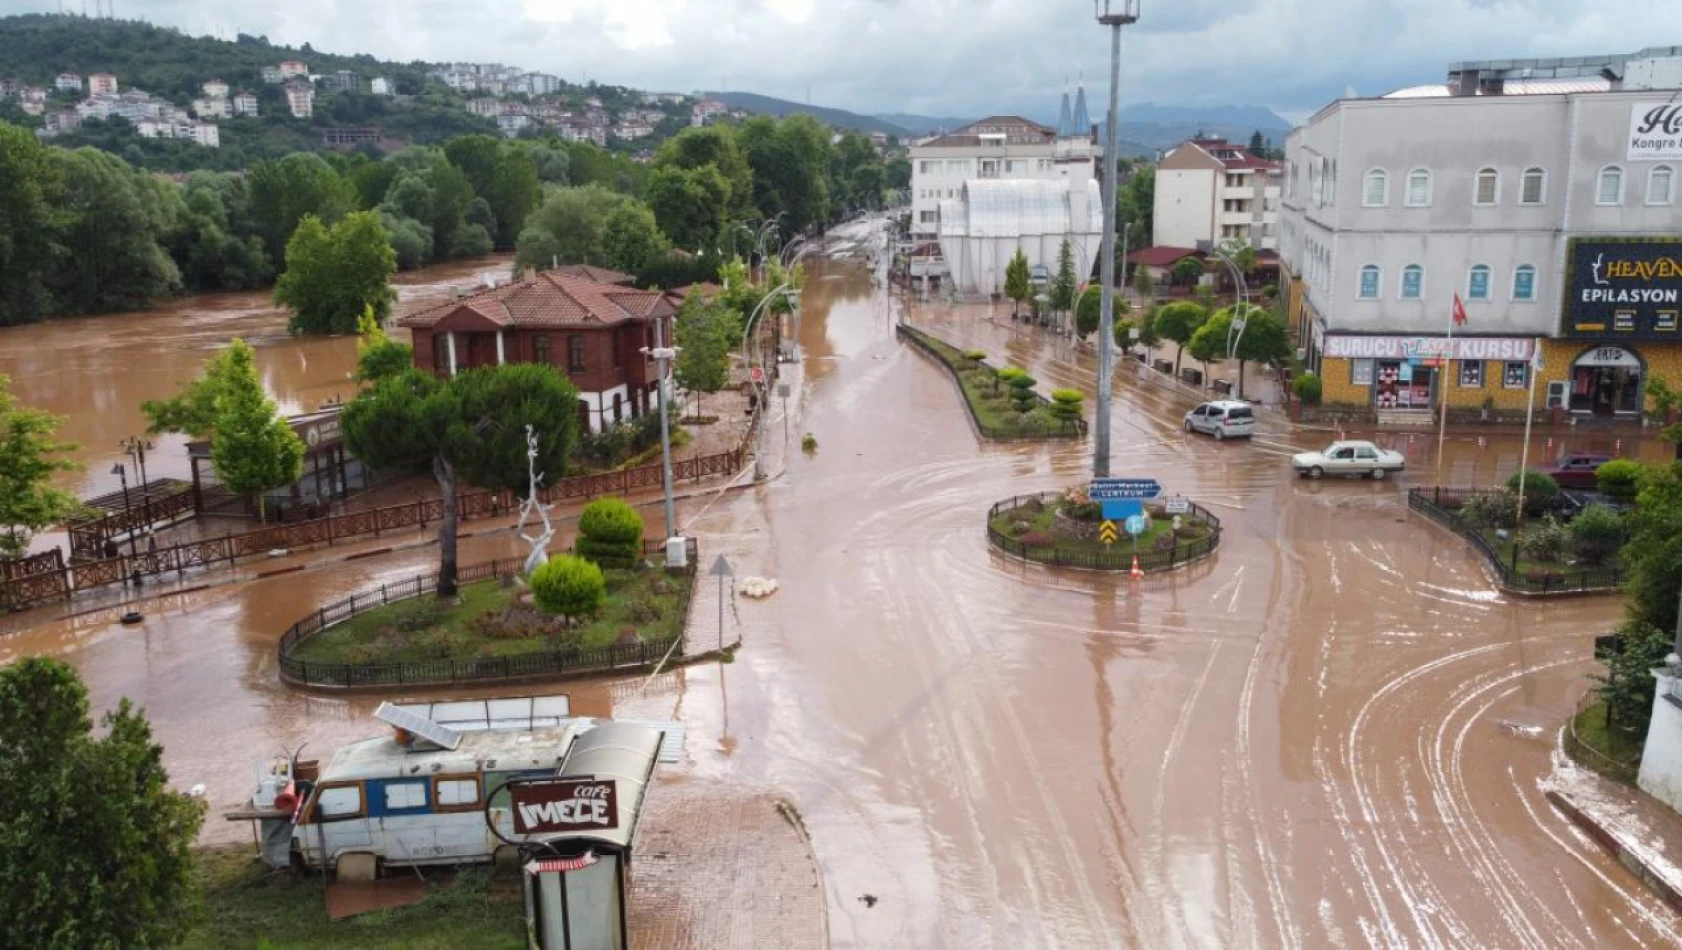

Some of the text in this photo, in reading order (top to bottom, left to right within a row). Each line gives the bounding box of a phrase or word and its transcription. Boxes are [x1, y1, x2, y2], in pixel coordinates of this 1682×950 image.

[1631, 137, 1676, 151] Kongre
[1606, 257, 1682, 280] HEAVEN
[1459, 339, 1528, 358] KURSU
[573, 784, 612, 799] cafe
